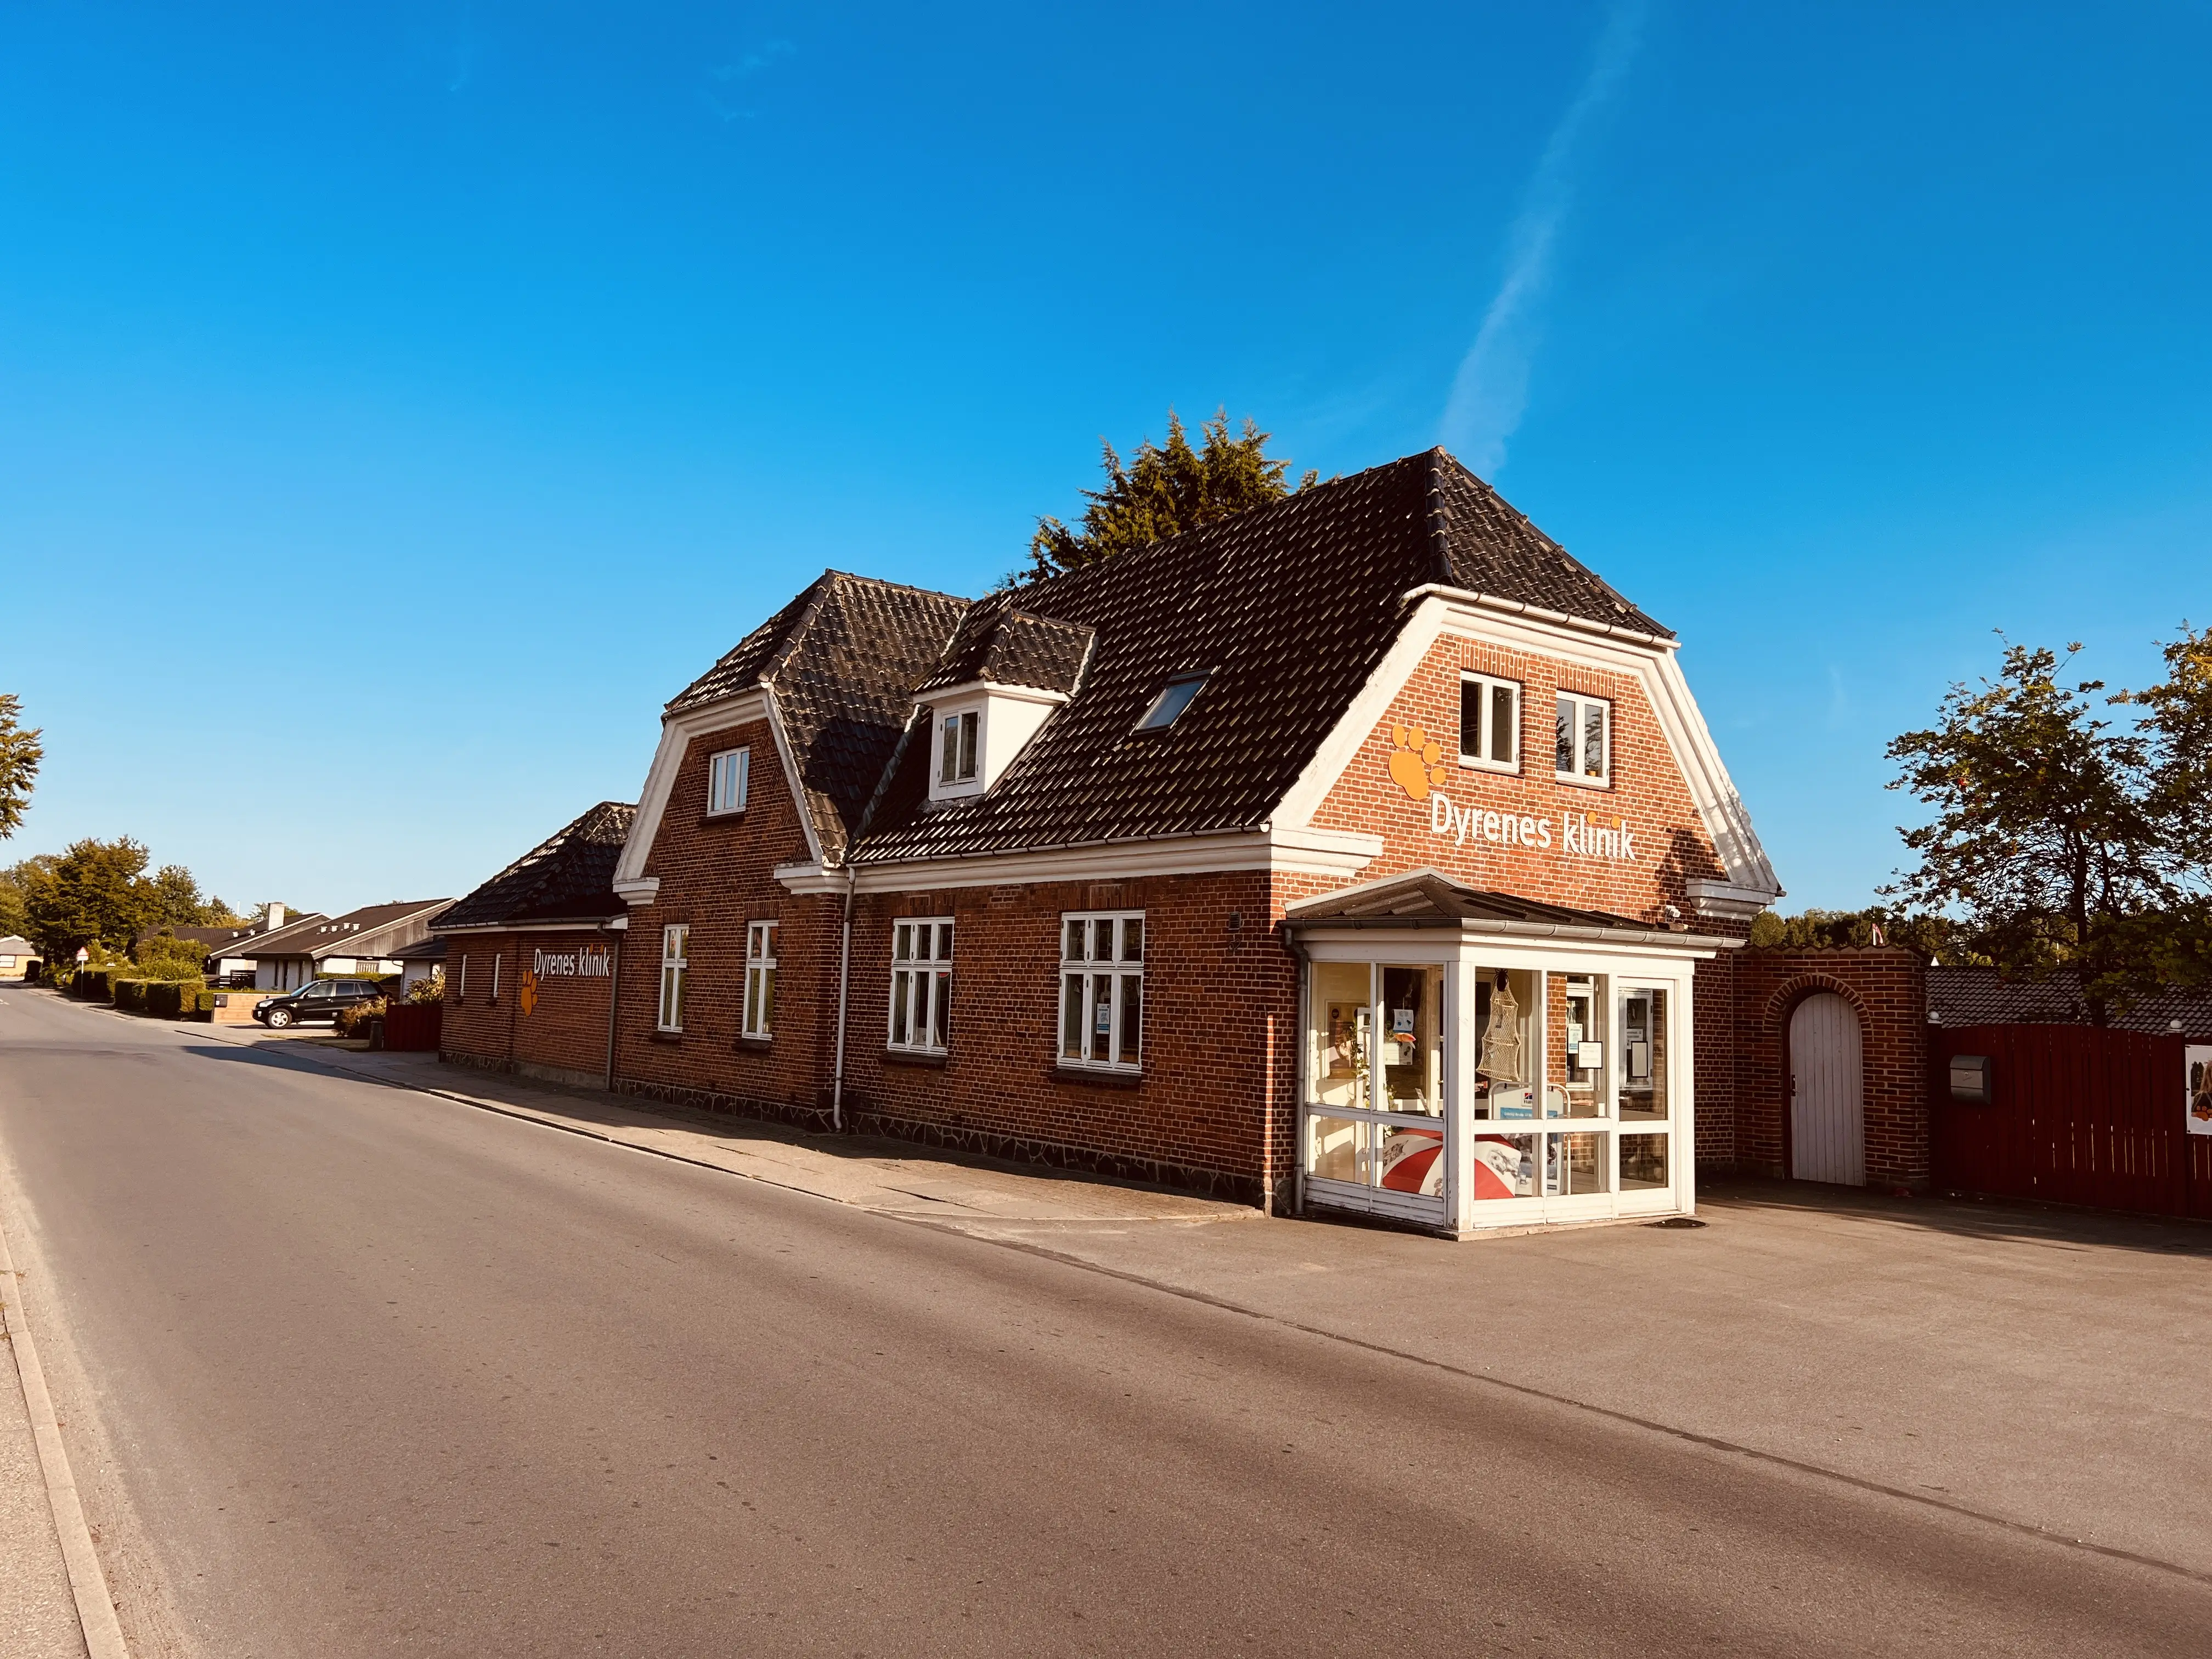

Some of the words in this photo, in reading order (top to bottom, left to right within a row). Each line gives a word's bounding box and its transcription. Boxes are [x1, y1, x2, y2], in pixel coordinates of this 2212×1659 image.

[1431, 792, 1551, 848] Dyrenes
[1562, 811, 1636, 860] klinik
[534, 948, 575, 981] Dyrenes
[578, 944, 610, 977] klinik
